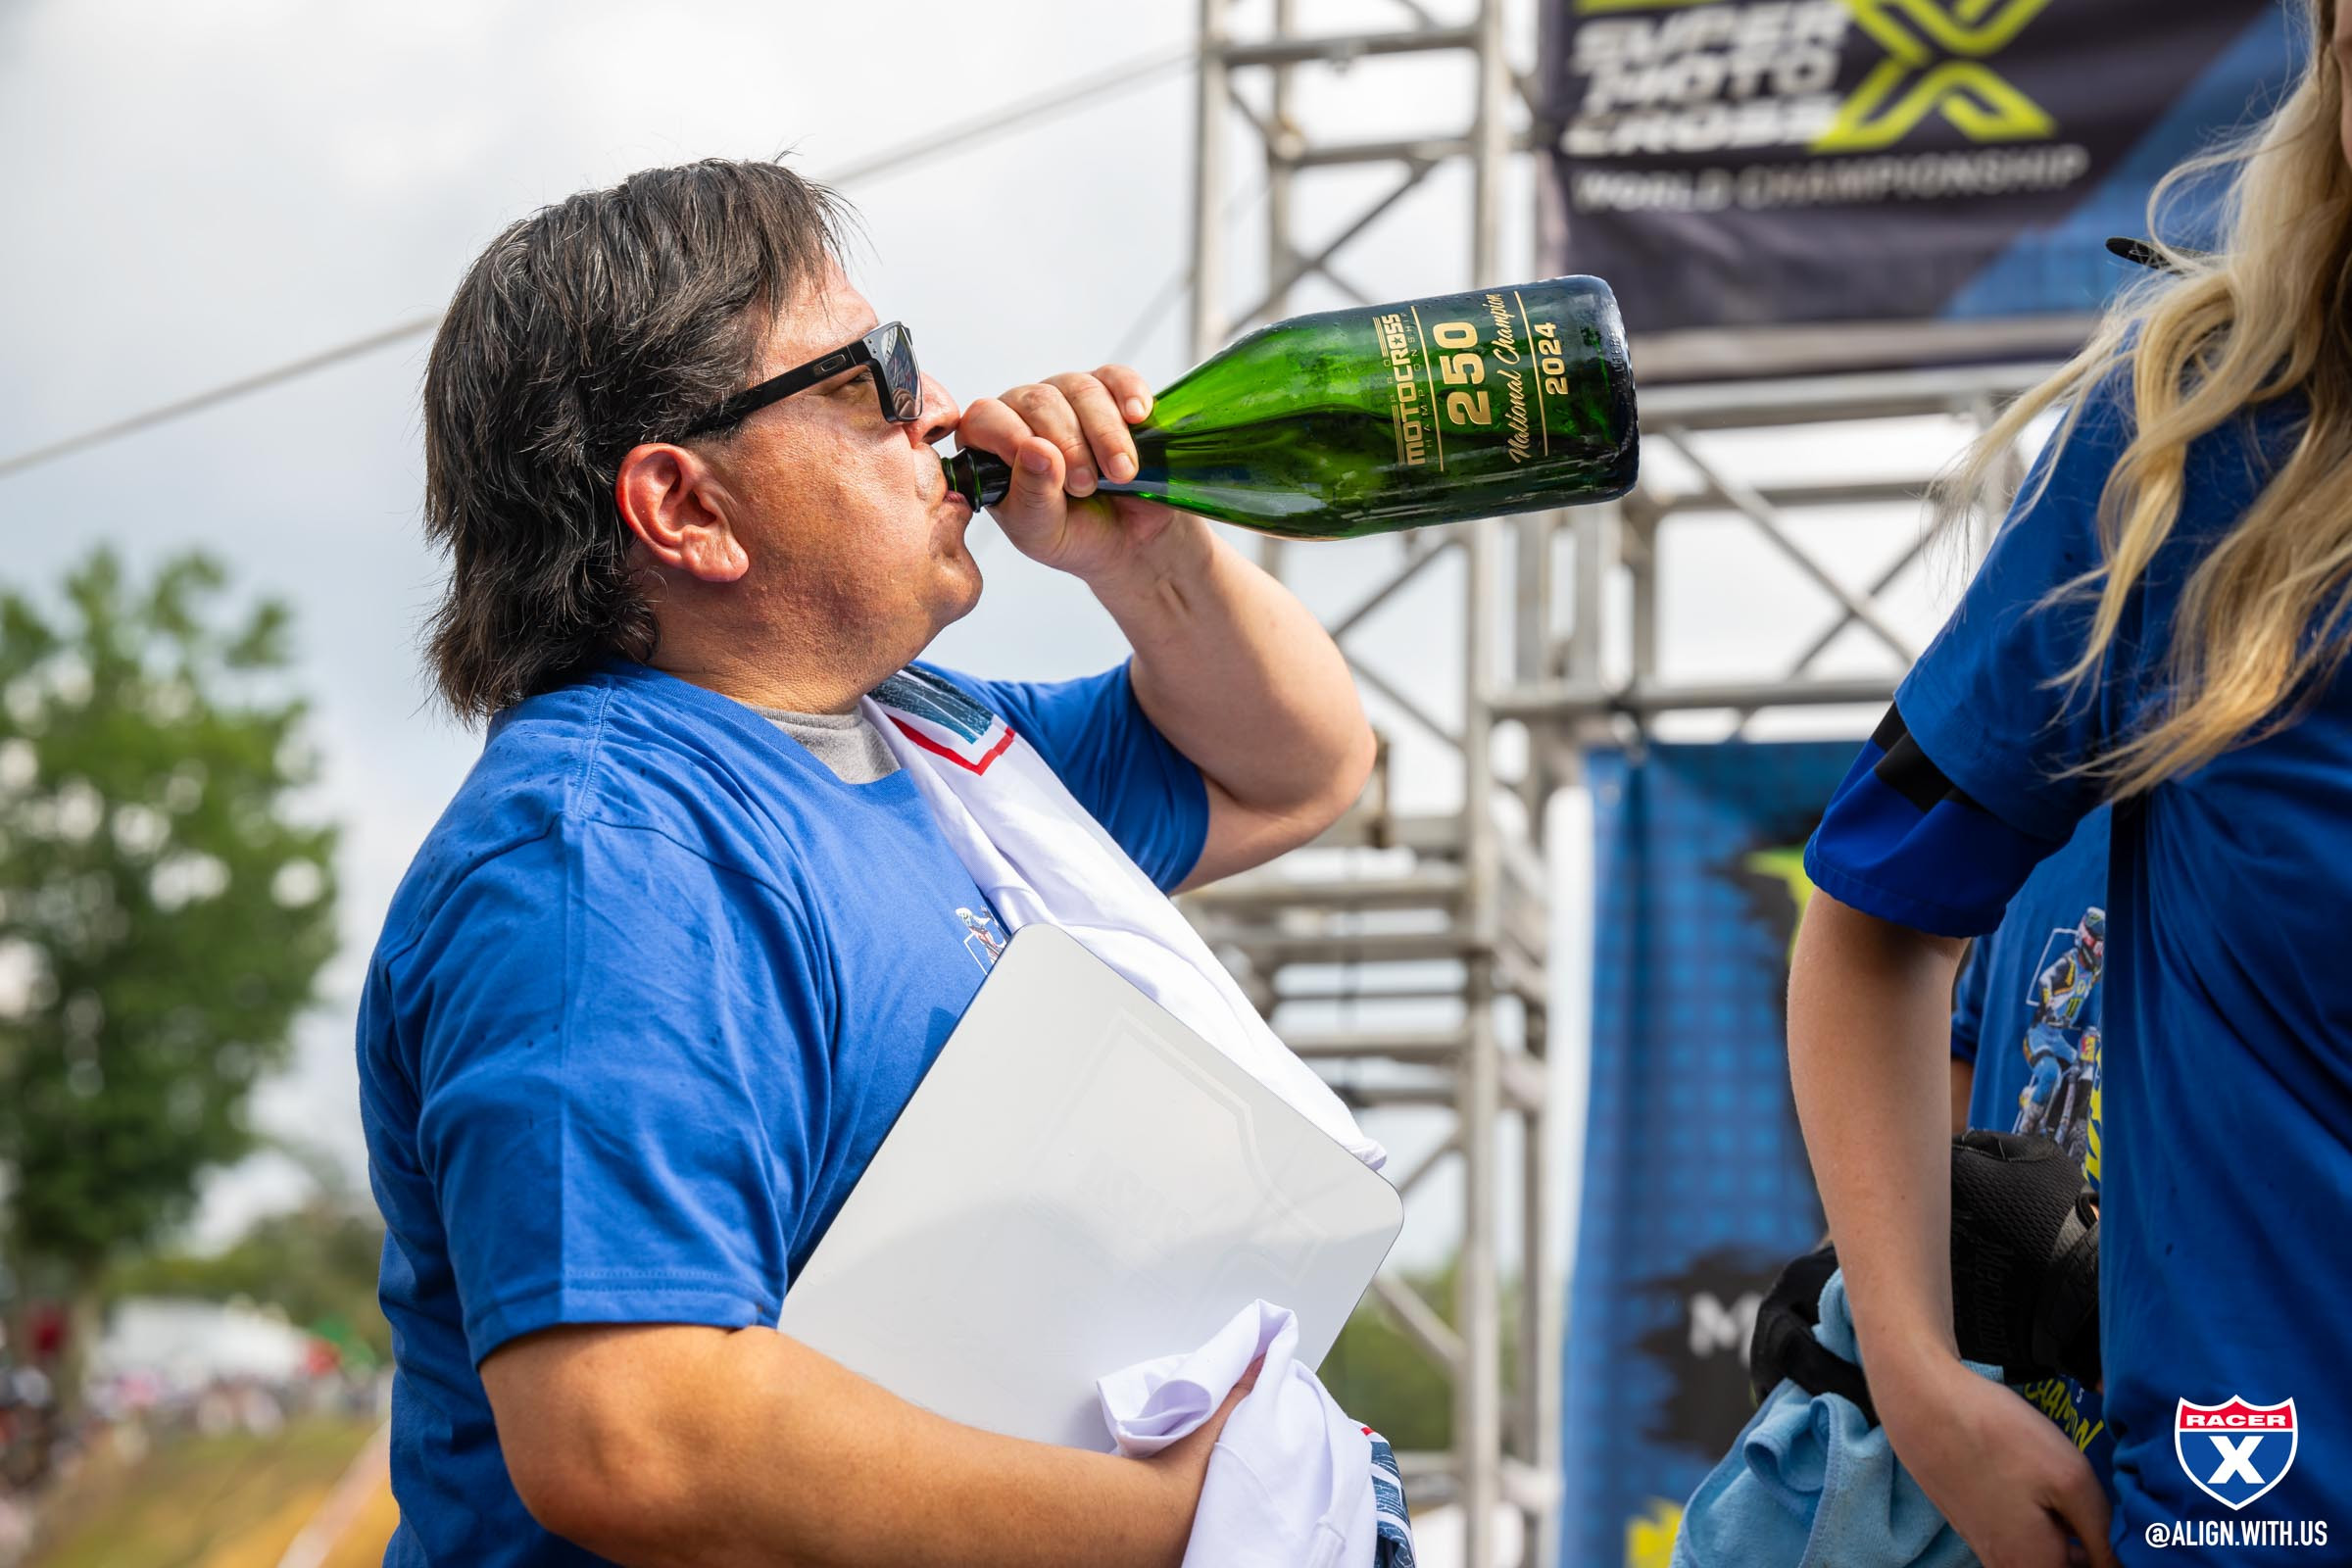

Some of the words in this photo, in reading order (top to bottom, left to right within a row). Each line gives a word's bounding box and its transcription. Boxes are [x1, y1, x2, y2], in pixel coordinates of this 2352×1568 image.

[1571, 0, 1852, 76] SUPER
[1578, 44, 1842, 118] MOTO
[1561, 96, 1846, 157] CROSS
[1577, 168, 1733, 214] WORLD
[1738, 145, 2090, 207] CHAMPIONSHIP
[1482, 293, 1521, 366] Champion
[1534, 321, 1568, 395] 2024
[1381, 314, 1426, 466] MOTOCROSS
[1383, 359, 1396, 403] PRO
[1433, 321, 1492, 425] 250
[1496, 368, 1532, 464] National
